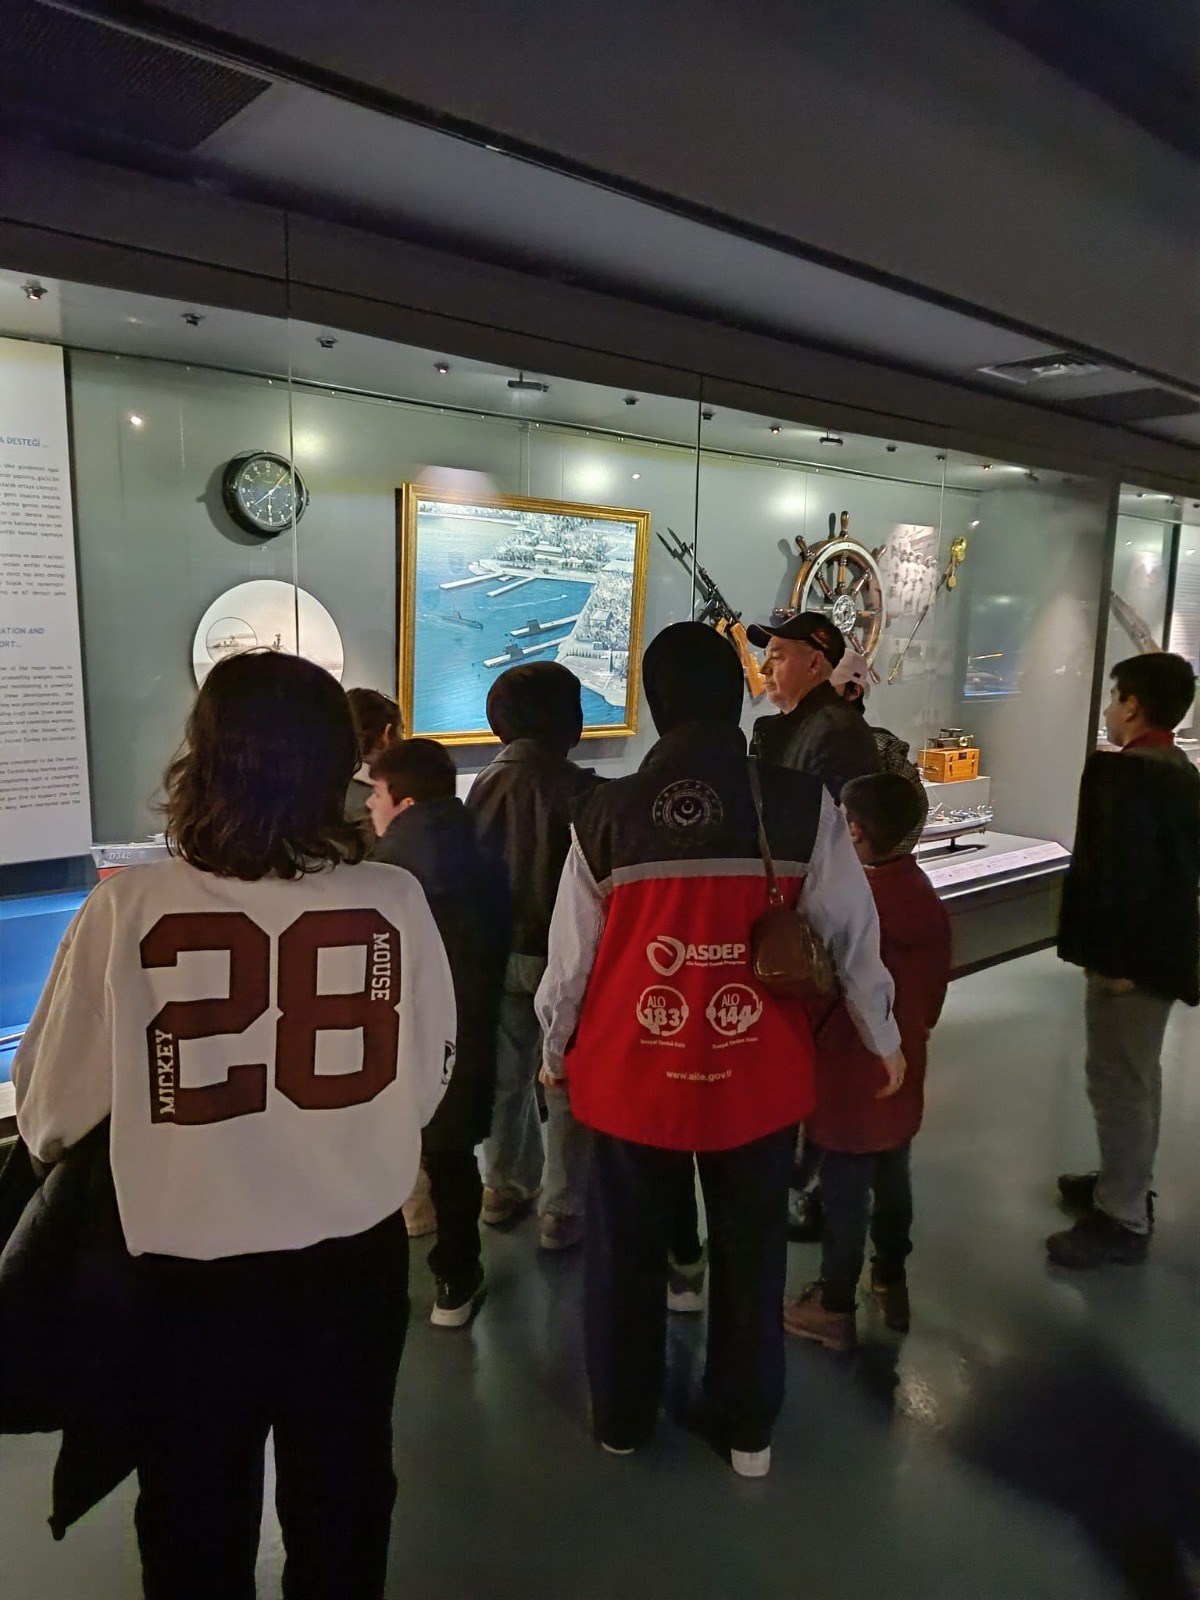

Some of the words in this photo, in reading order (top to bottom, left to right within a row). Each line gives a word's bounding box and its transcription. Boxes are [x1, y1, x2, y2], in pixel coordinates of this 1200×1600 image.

[685, 943, 746, 961] ASDEP
[371, 932, 390, 1001] MOUSE
[647, 995, 666, 1008] ALO
[721, 993, 740, 1006] ALO
[139, 908, 401, 1125] 28
[643, 1008, 680, 1027] 183
[717, 1005, 752, 1027] 144
[154, 1029, 175, 1115] MICKEY
[666, 1069, 732, 1082] www.aile.gov.tr
